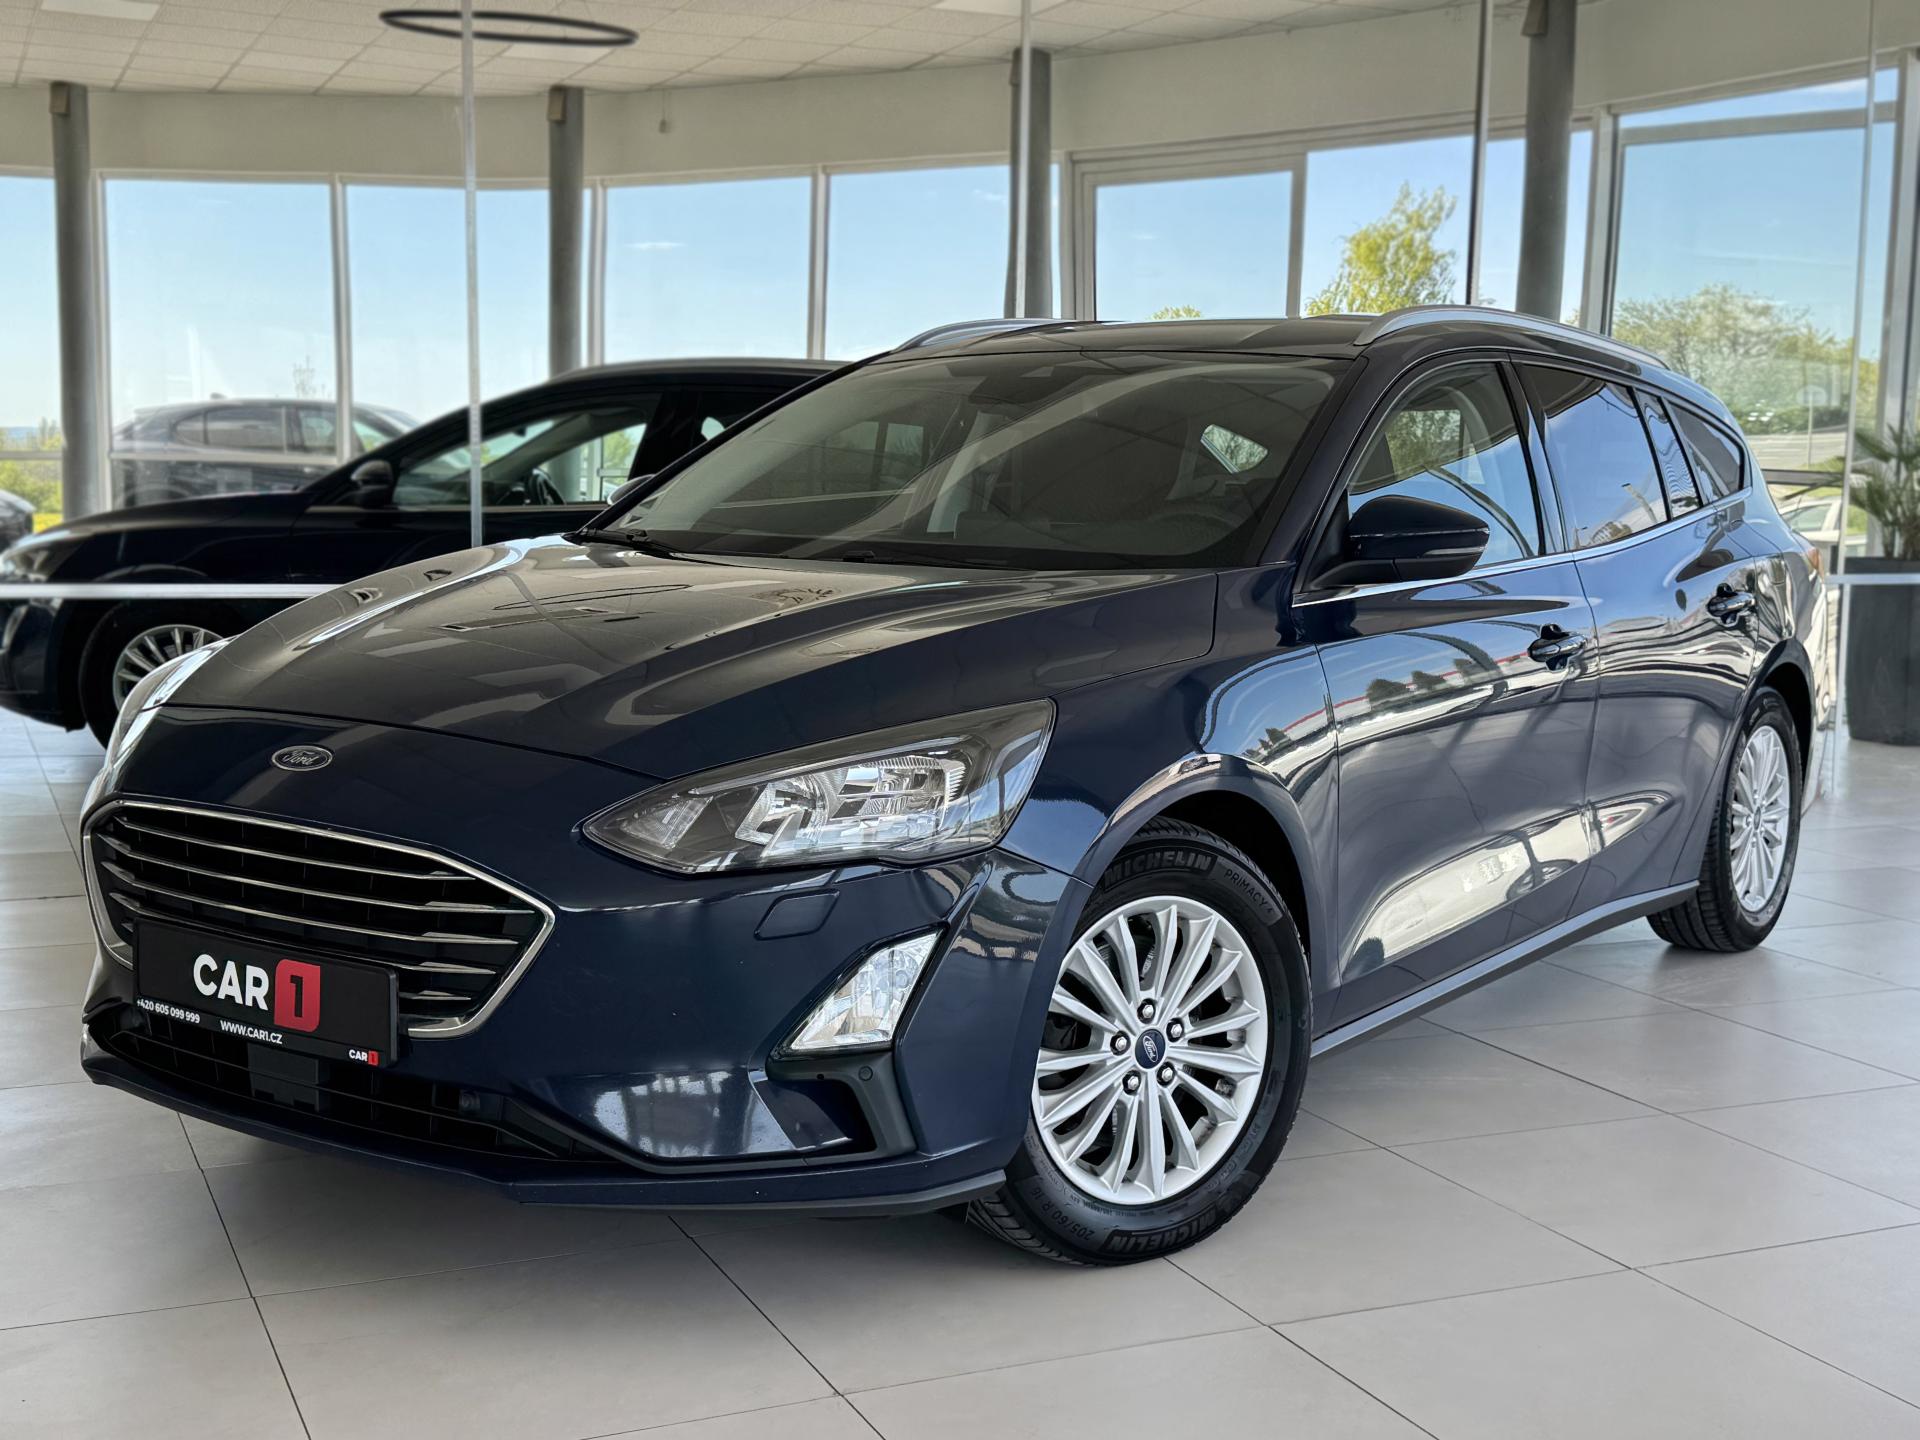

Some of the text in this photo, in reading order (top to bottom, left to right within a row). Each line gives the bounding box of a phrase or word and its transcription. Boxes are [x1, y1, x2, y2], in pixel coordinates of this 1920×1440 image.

[281, 750, 320, 766] Ford
[1103, 851, 1213, 887] MICHELIN
[1224, 868, 1267, 907] PRIMACY
[137, 999, 200, 1024] +420 605 099 999
[220, 1020, 283, 1044] WWW.CAR1.CZ
[1051, 1210, 1095, 1241] 205/60
[1109, 1209, 1216, 1251] MICHELIN
